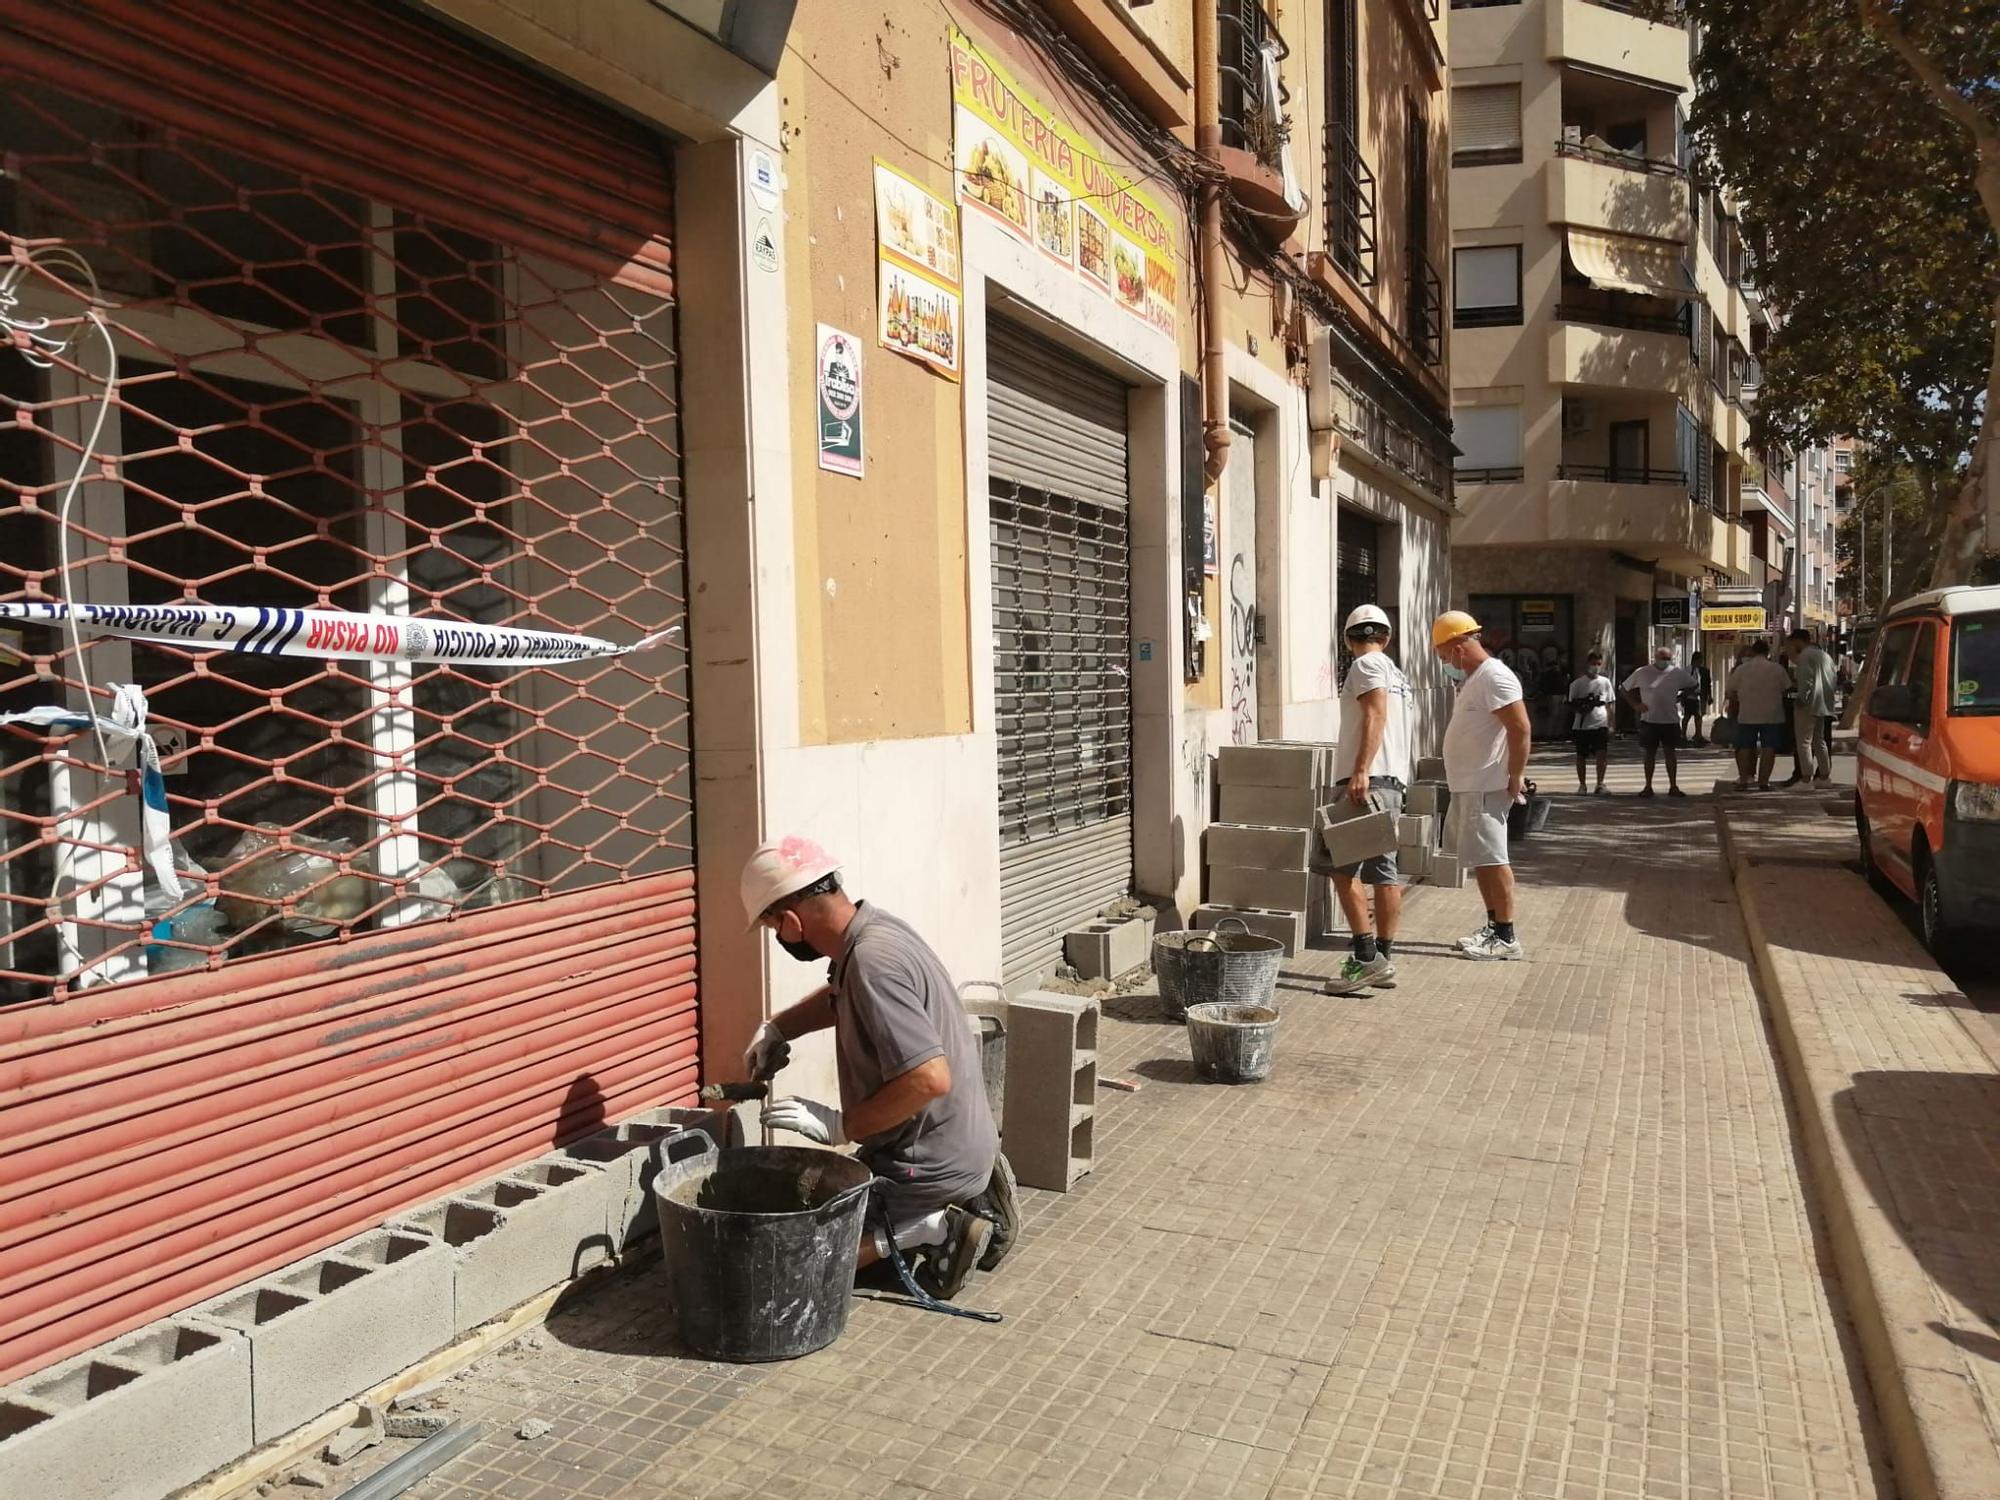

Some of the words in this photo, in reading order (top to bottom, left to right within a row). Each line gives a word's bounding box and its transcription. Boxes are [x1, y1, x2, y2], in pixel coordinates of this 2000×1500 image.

[952, 44, 1075, 179] FRUTERÍA
[1081, 152, 1174, 260] UNIVERSAL
[1710, 615, 1733, 624] INDIAN
[1734, 614, 1752, 624] SHOP
[306, 618, 369, 652] PASAR
[374, 624, 399, 655] NO
[499, 634, 520, 658] DE
